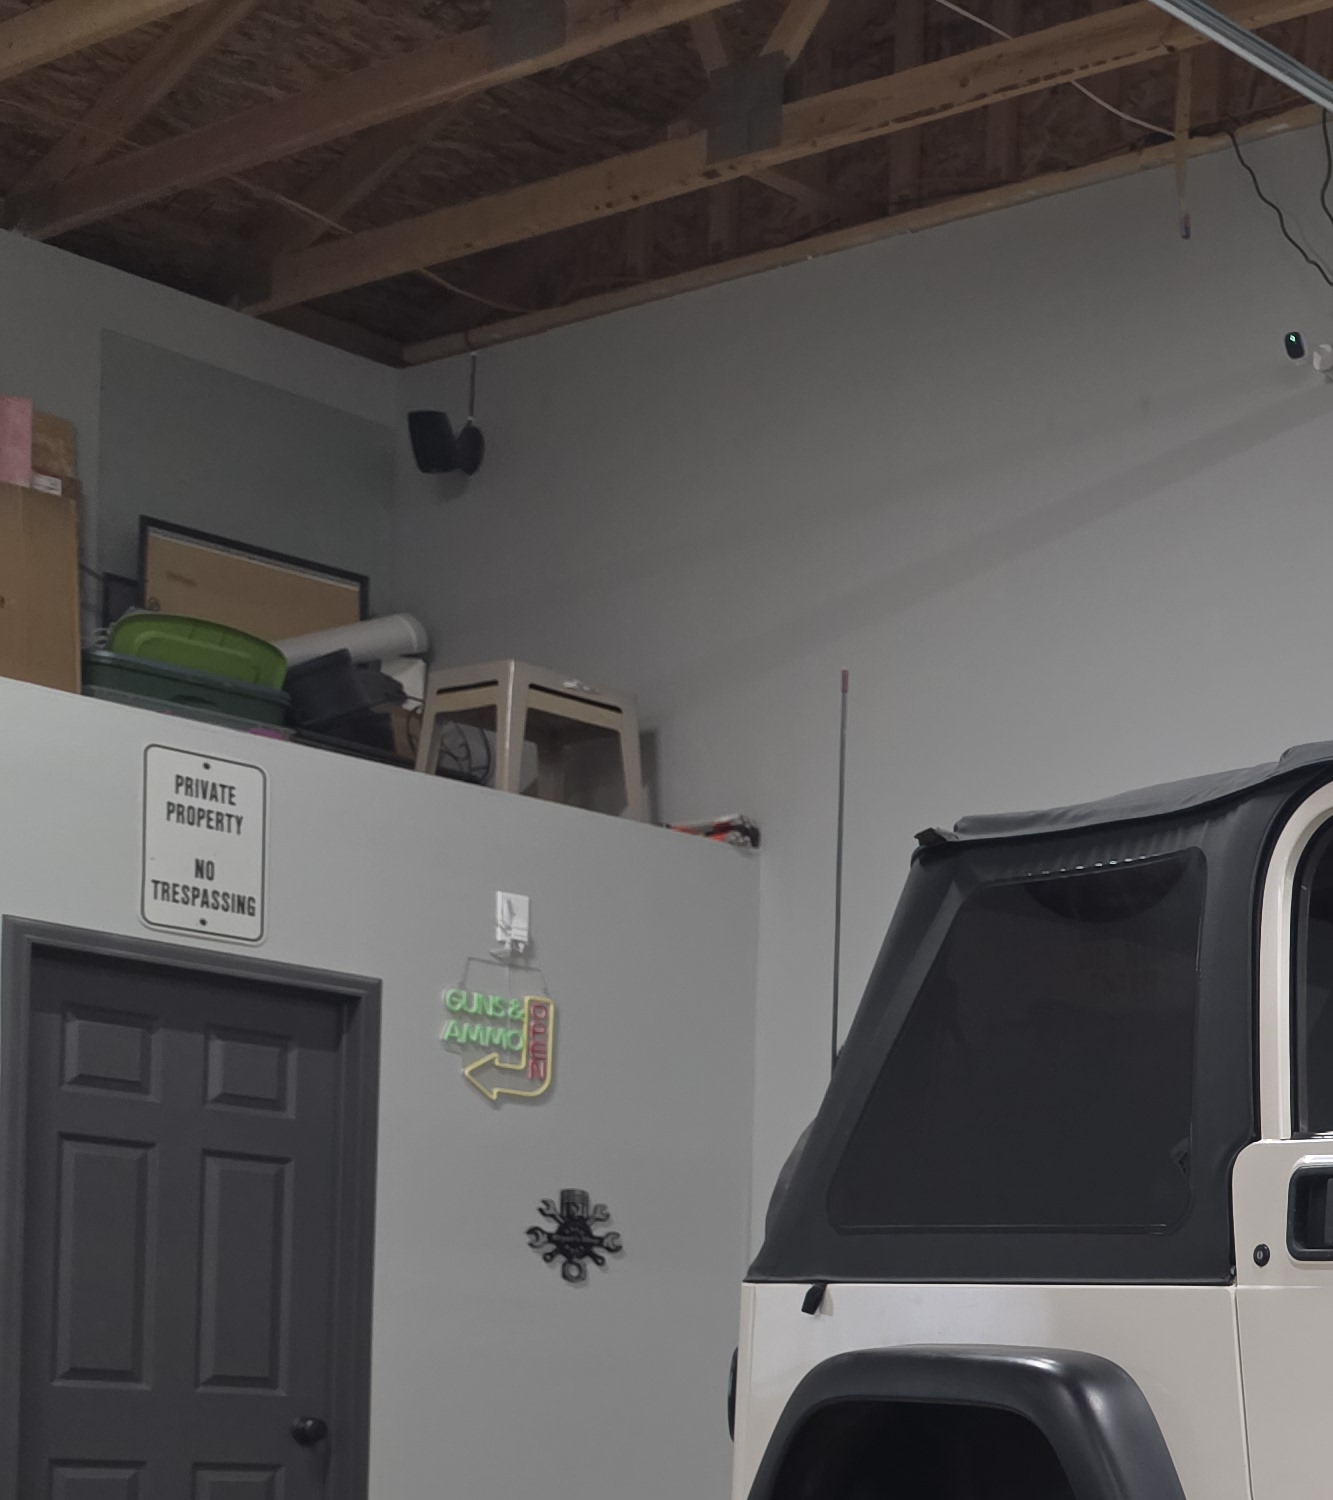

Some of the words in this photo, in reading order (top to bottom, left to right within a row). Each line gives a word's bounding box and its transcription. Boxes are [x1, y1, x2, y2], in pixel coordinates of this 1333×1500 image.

[175, 774, 237, 807] PRIVATE
[166, 801, 244, 836] PROPERTY
[194, 857, 215, 882] NO
[151, 879, 257, 917] TRESPASSING
[443, 1019, 526, 1052] AMMO
